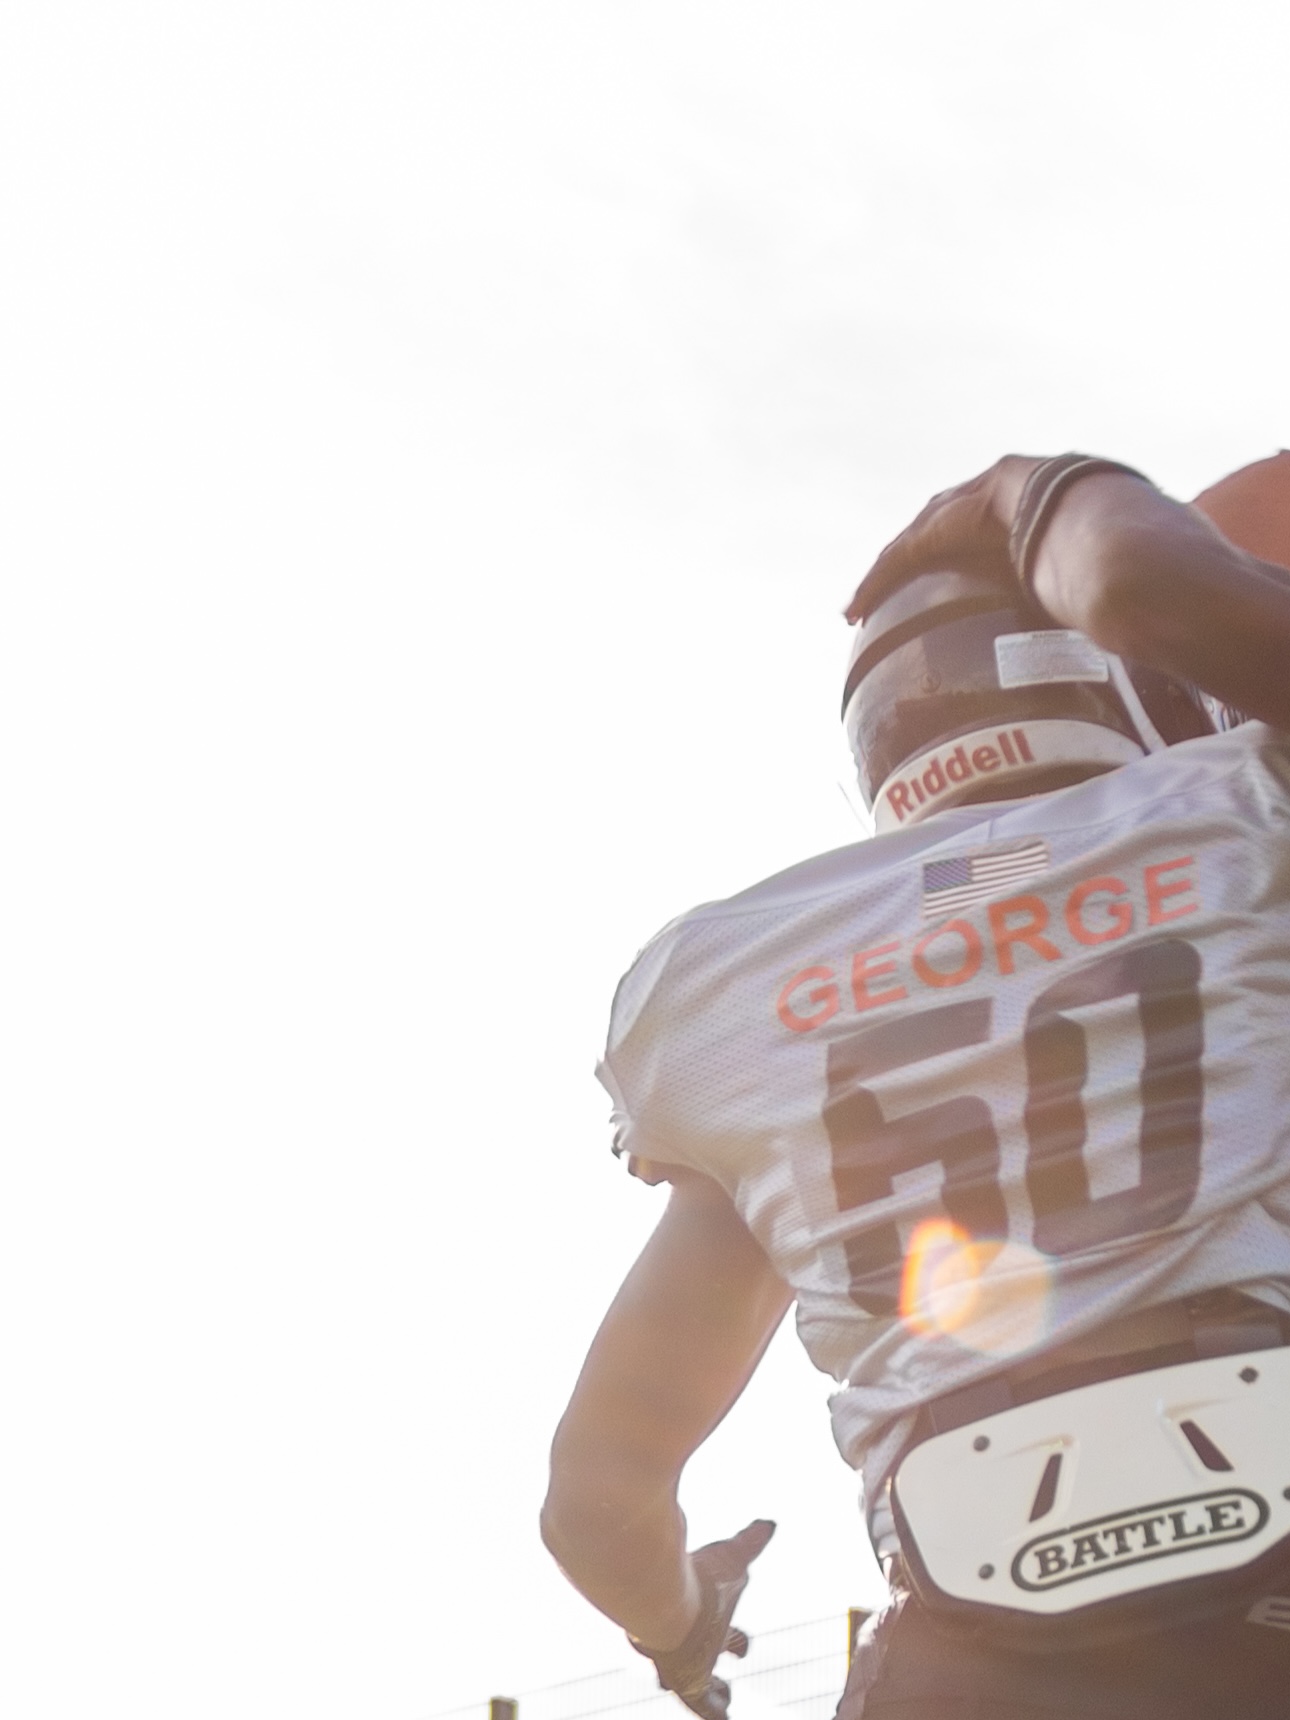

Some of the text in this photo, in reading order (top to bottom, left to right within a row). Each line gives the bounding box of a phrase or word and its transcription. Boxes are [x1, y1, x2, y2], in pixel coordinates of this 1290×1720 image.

[886, 728, 1034, 822] Riddell
[777, 856, 1198, 1033] GEORGE
[822, 938, 1205, 1322] 50
[1034, 1500, 1246, 1579] BATTLE
